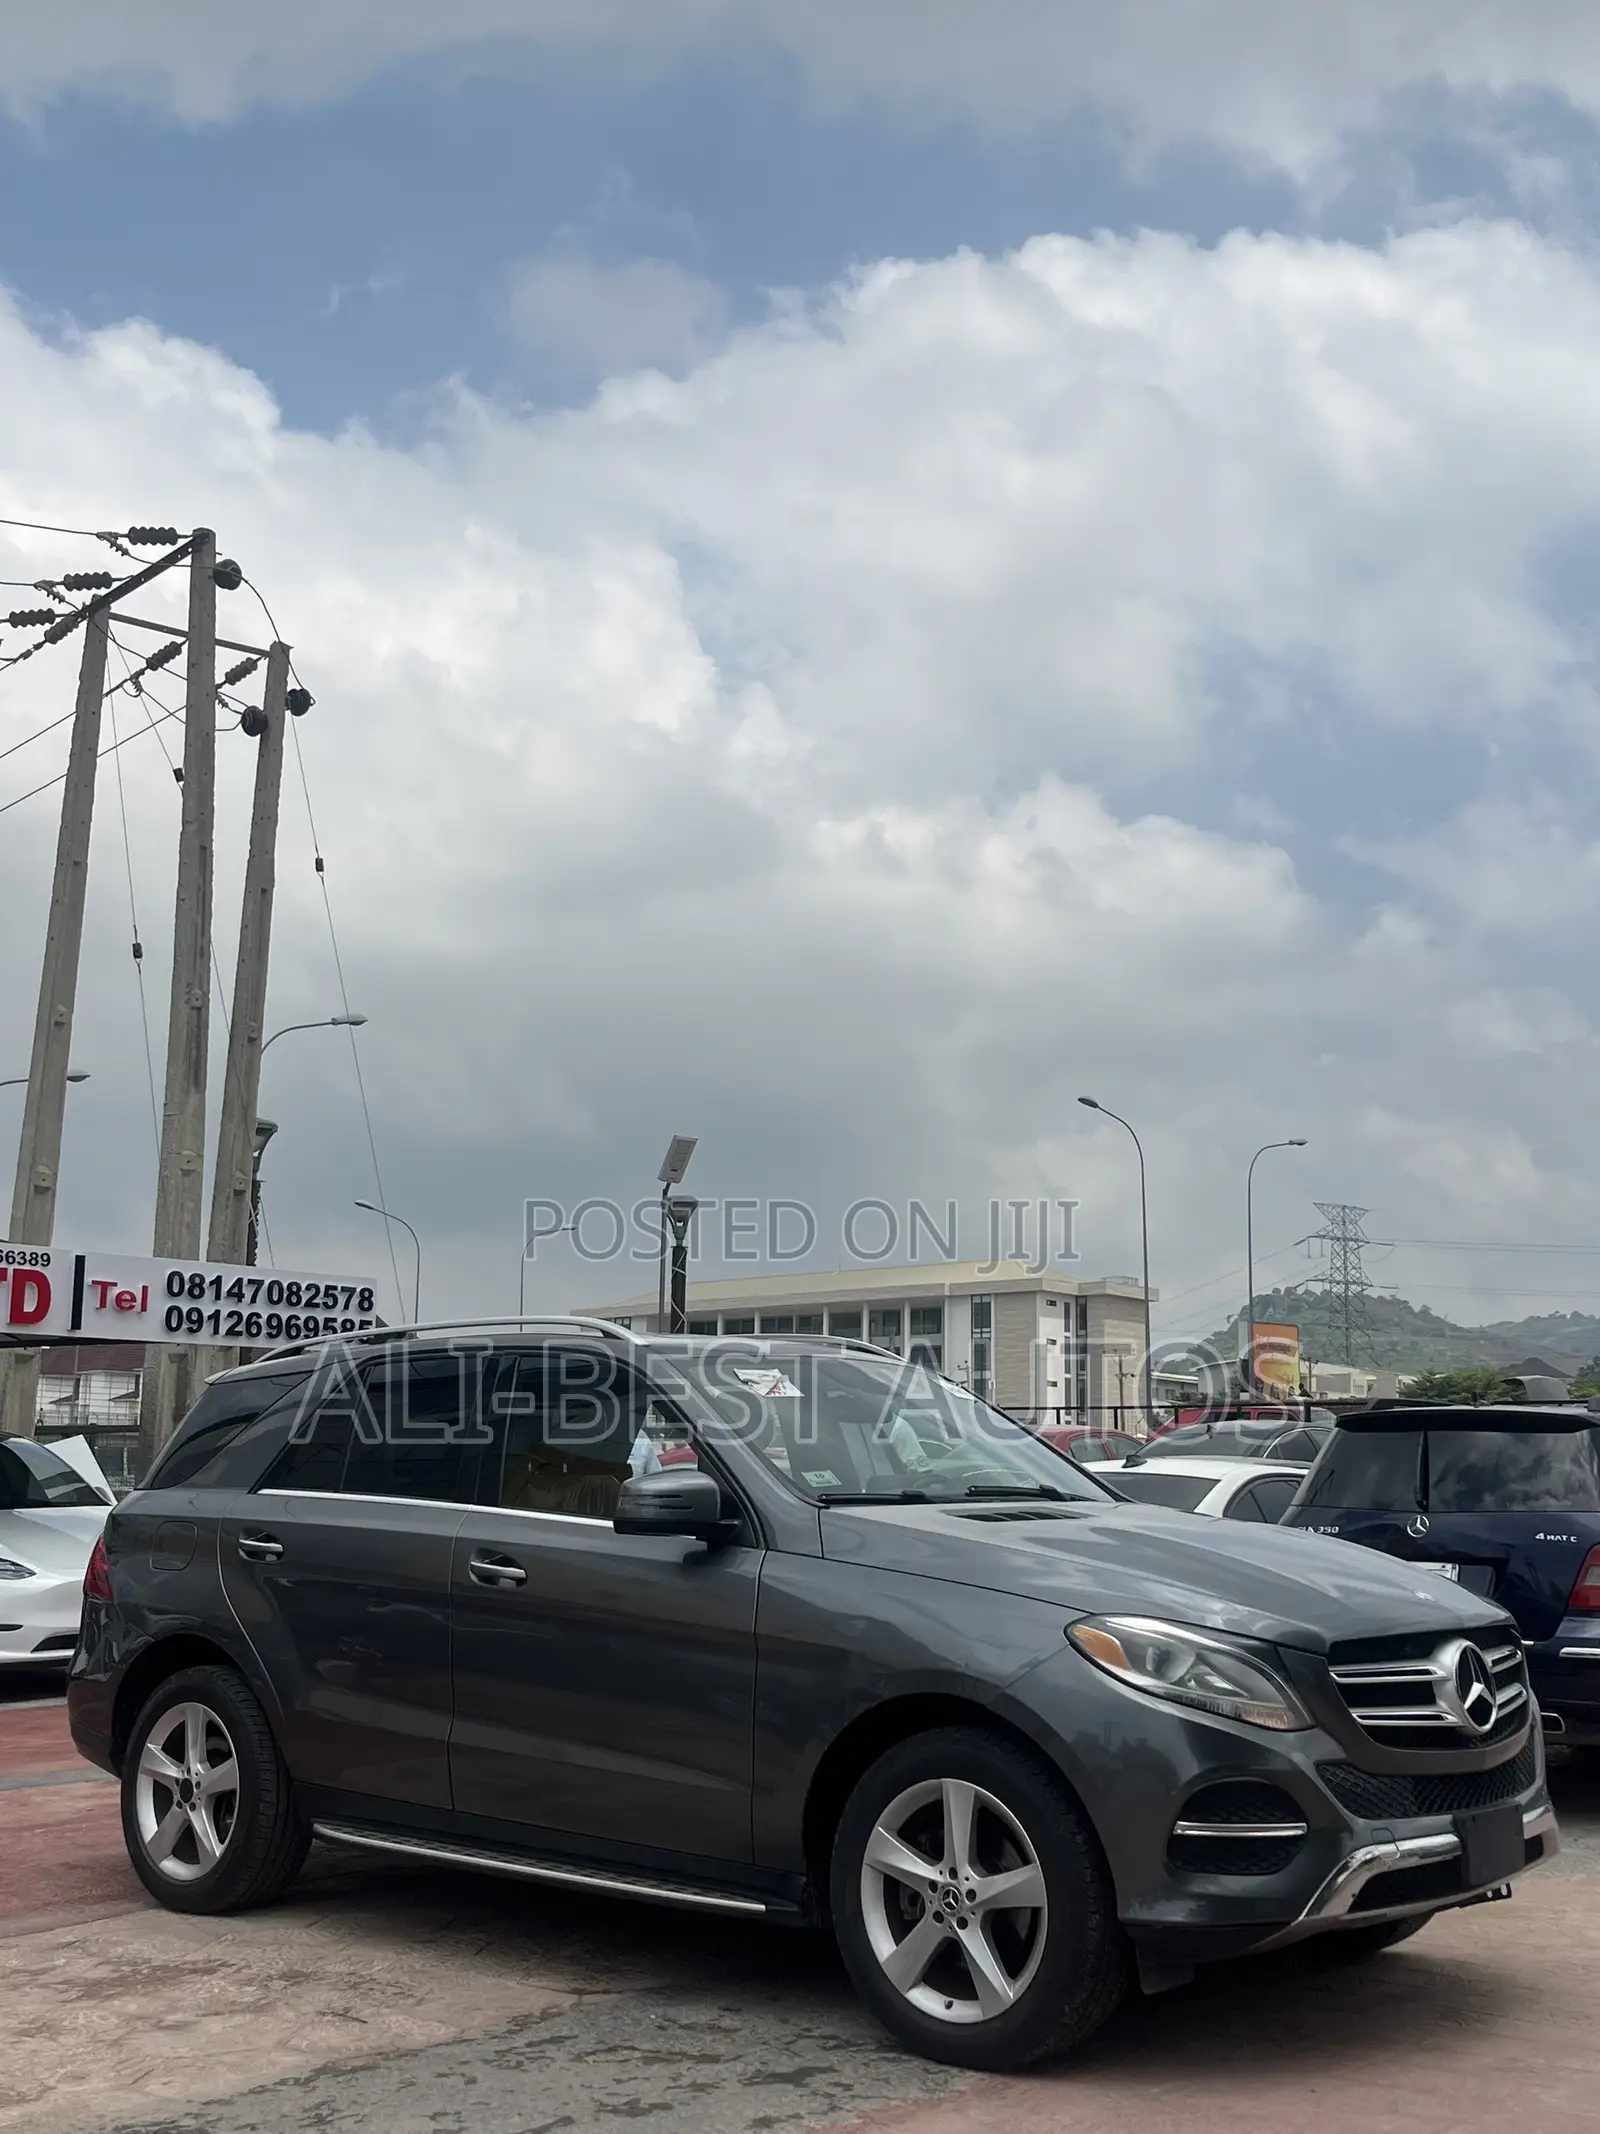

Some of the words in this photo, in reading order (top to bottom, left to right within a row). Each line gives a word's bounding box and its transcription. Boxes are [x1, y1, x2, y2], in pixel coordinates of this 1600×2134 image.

[91, 1280, 149, 1312] Tel
[166, 1271, 374, 1312] 08147082578
[1317, 1526, 1340, 1534] 350
